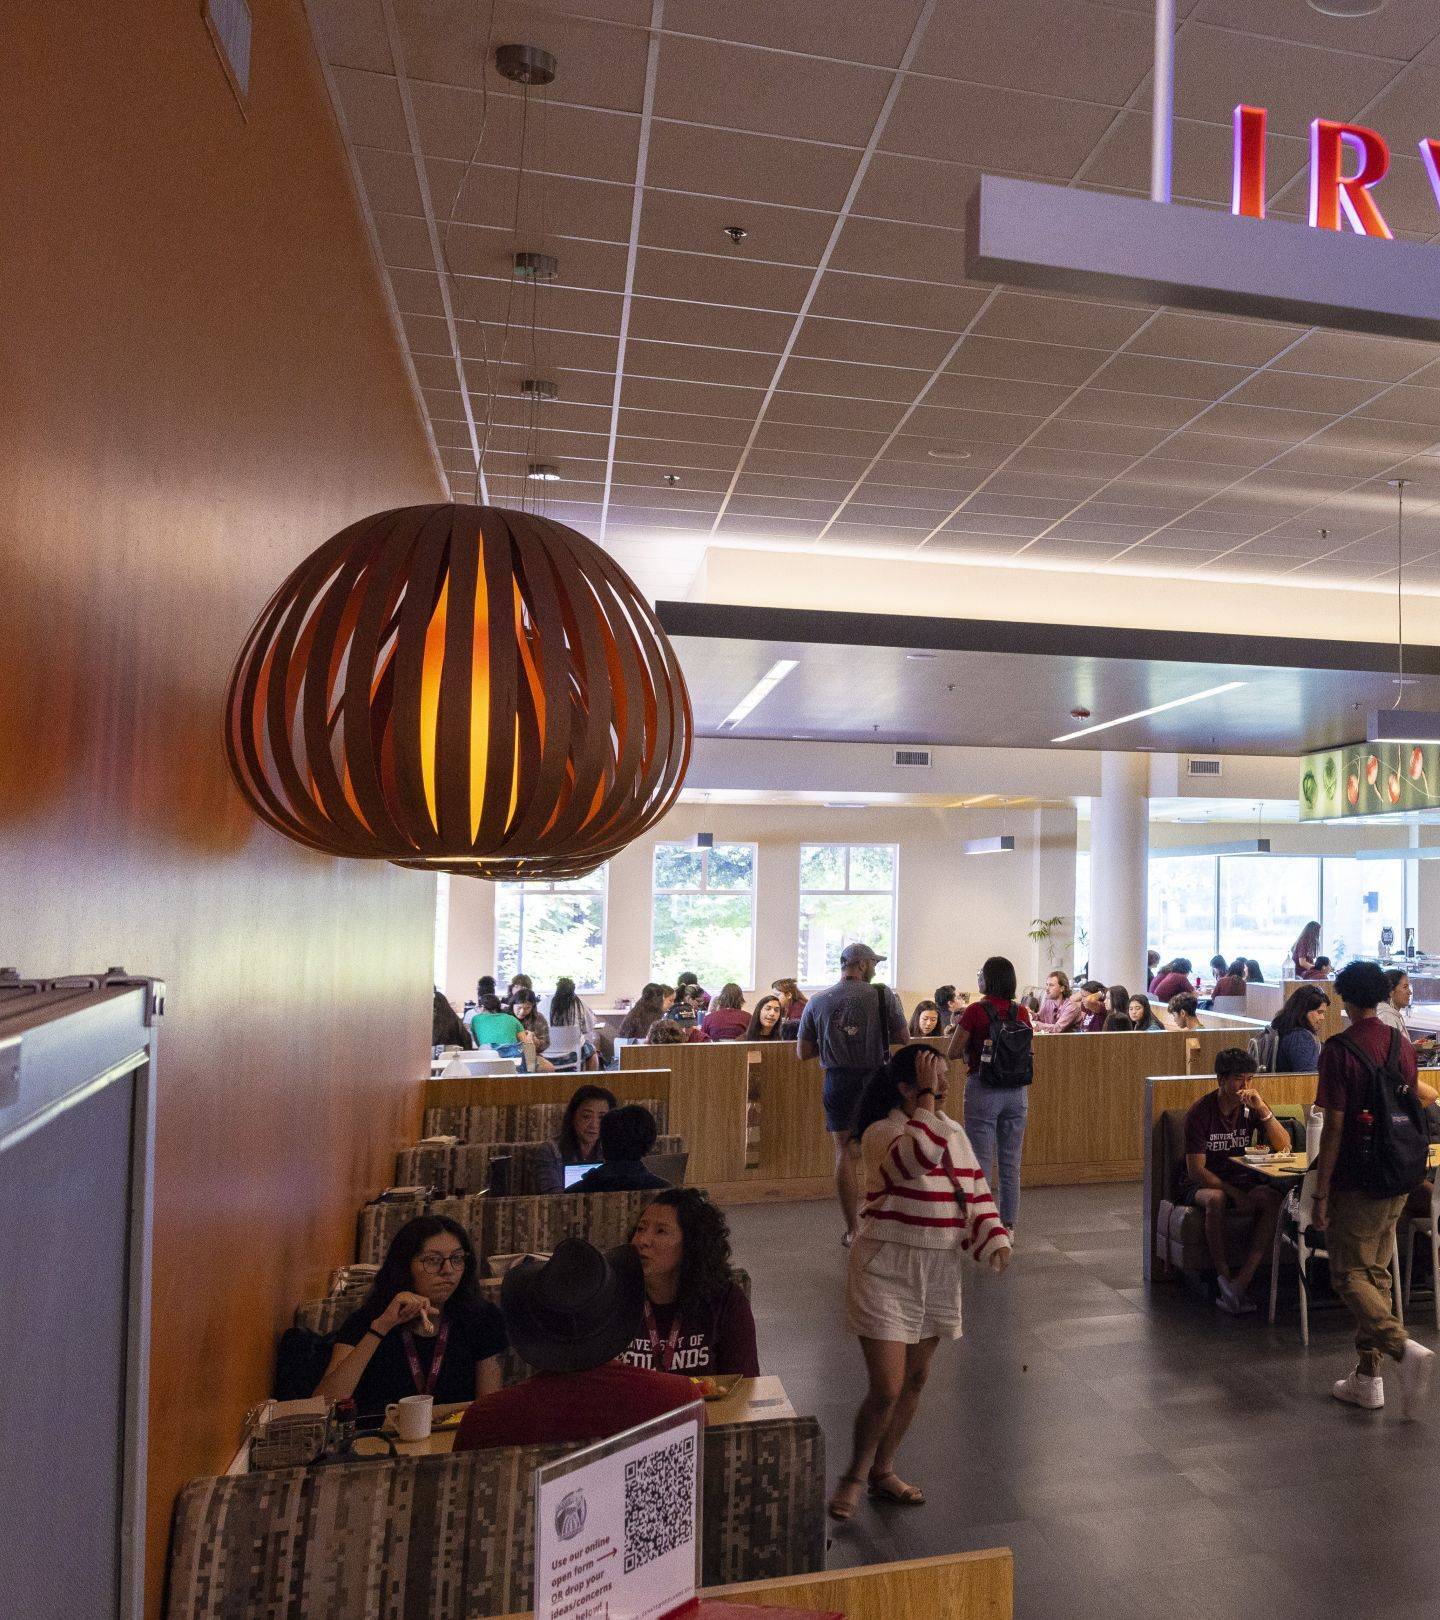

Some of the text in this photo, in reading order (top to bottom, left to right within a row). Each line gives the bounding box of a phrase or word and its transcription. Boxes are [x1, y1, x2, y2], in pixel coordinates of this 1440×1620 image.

[690, 1334, 704, 1346] OF
[551, 1536, 610, 1570] Use our online
[551, 1560, 594, 1588] open form
[551, 1571, 605, 1603] OR drop your
